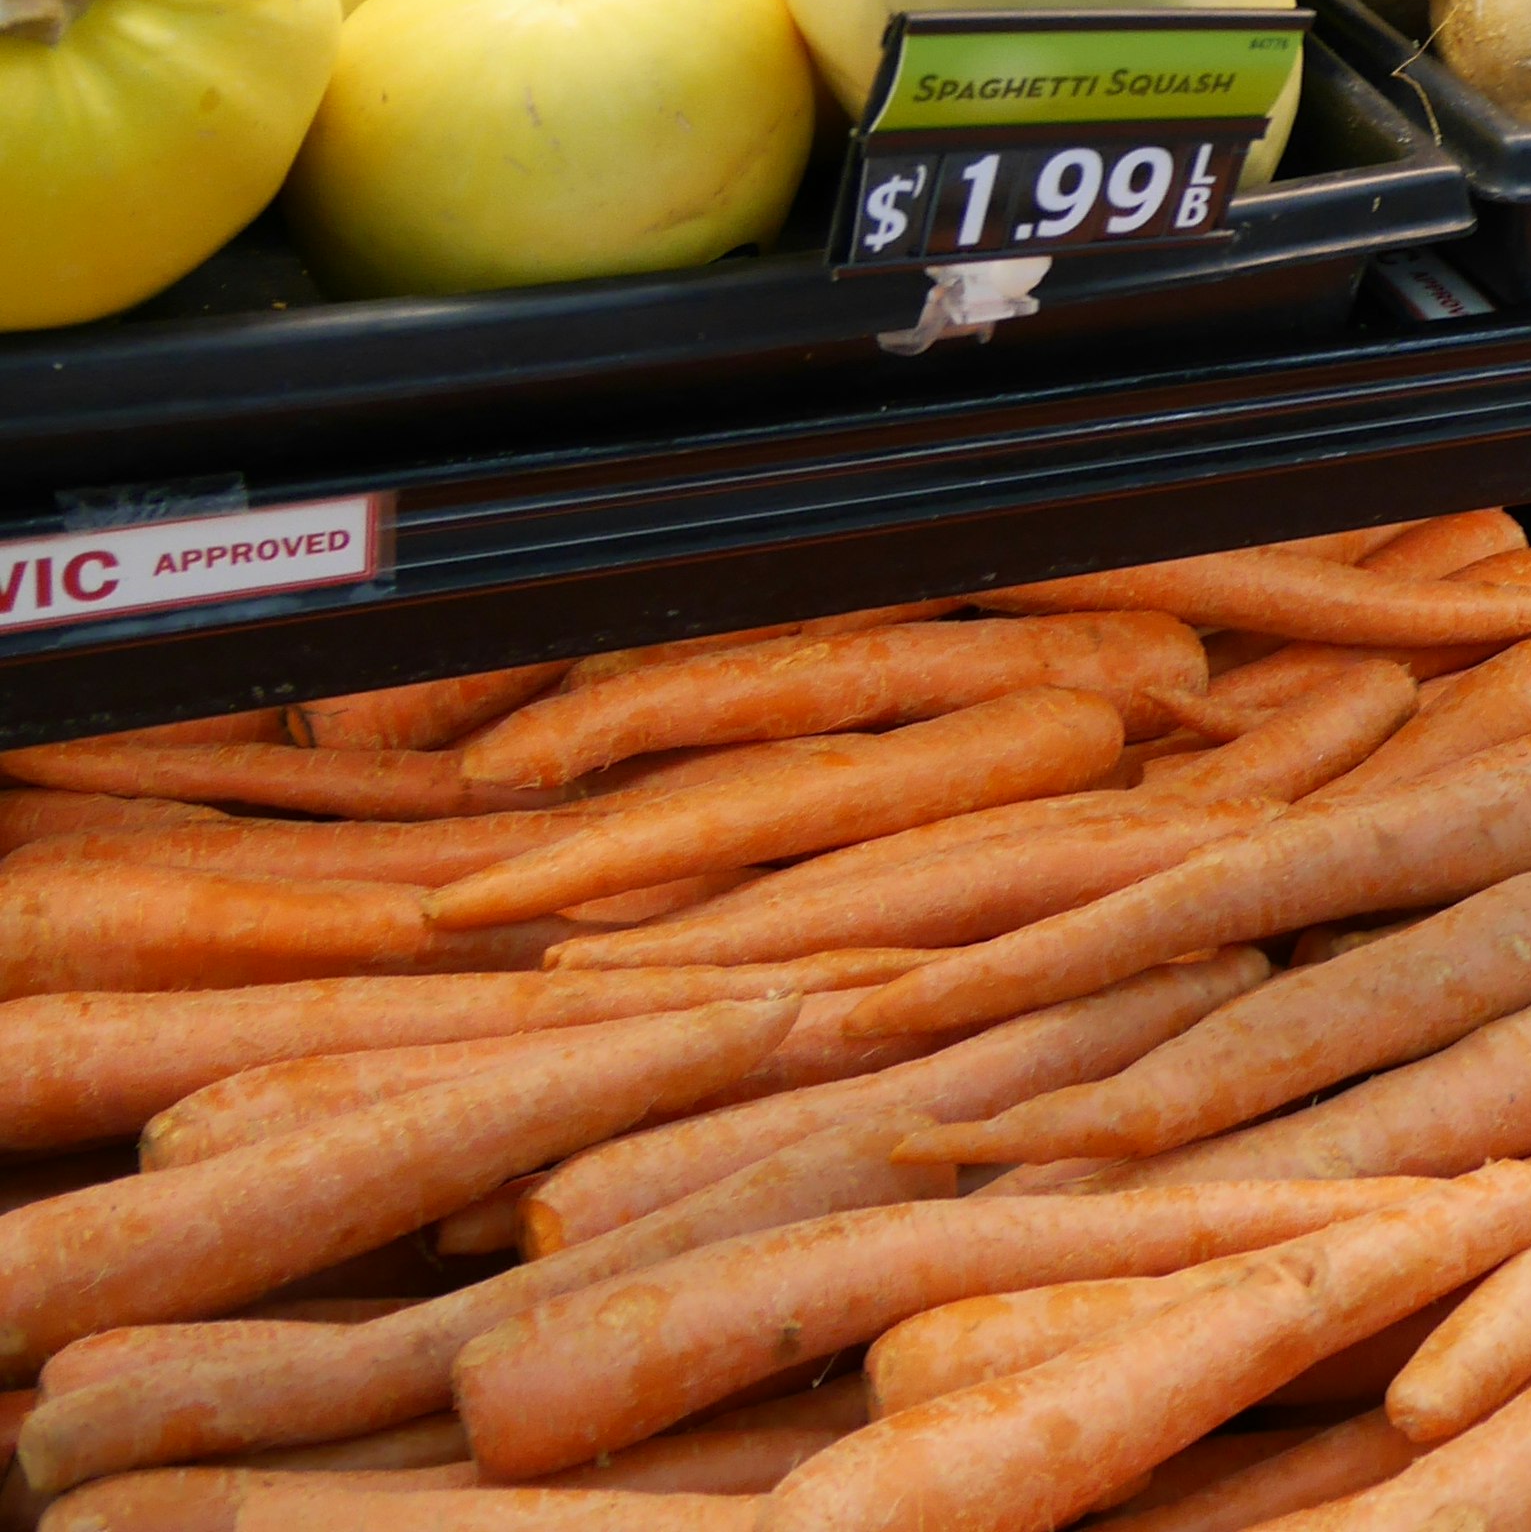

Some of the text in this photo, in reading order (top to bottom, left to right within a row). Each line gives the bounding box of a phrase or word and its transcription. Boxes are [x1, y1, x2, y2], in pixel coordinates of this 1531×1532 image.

[913, 68, 1236, 103] SPAGHETTI SQUASH
[153, 529, 350, 577] APPROVED
